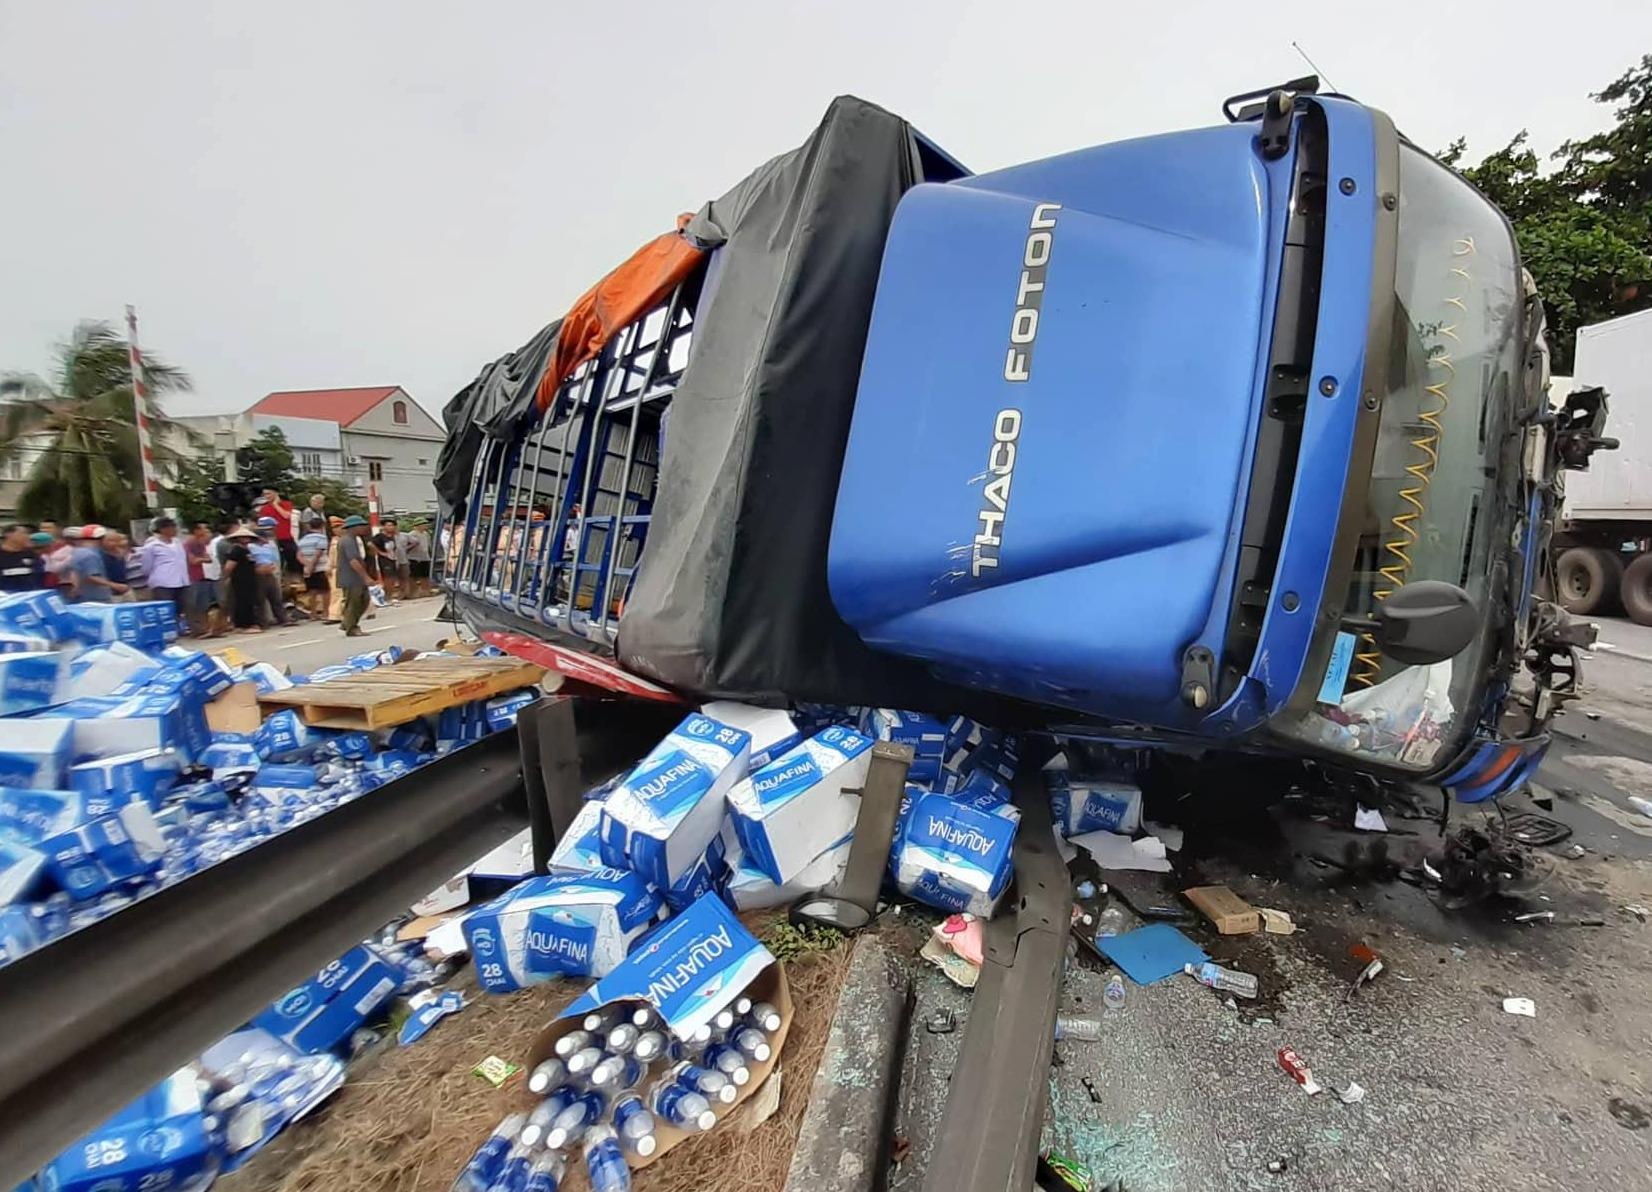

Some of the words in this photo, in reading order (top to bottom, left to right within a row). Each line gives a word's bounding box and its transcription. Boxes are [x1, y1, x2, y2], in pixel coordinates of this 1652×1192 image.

[971, 408, 1022, 577] THACO
[715, 728, 733, 742] 28
[634, 760, 700, 802] AQUAFINA
[754, 761, 815, 793] AQUAFINA
[928, 814, 996, 856] AQUAFINA
[525, 931, 589, 961] AQUAFINA
[481, 963, 502, 978] 28
[101, 1138, 128, 1166] 28
